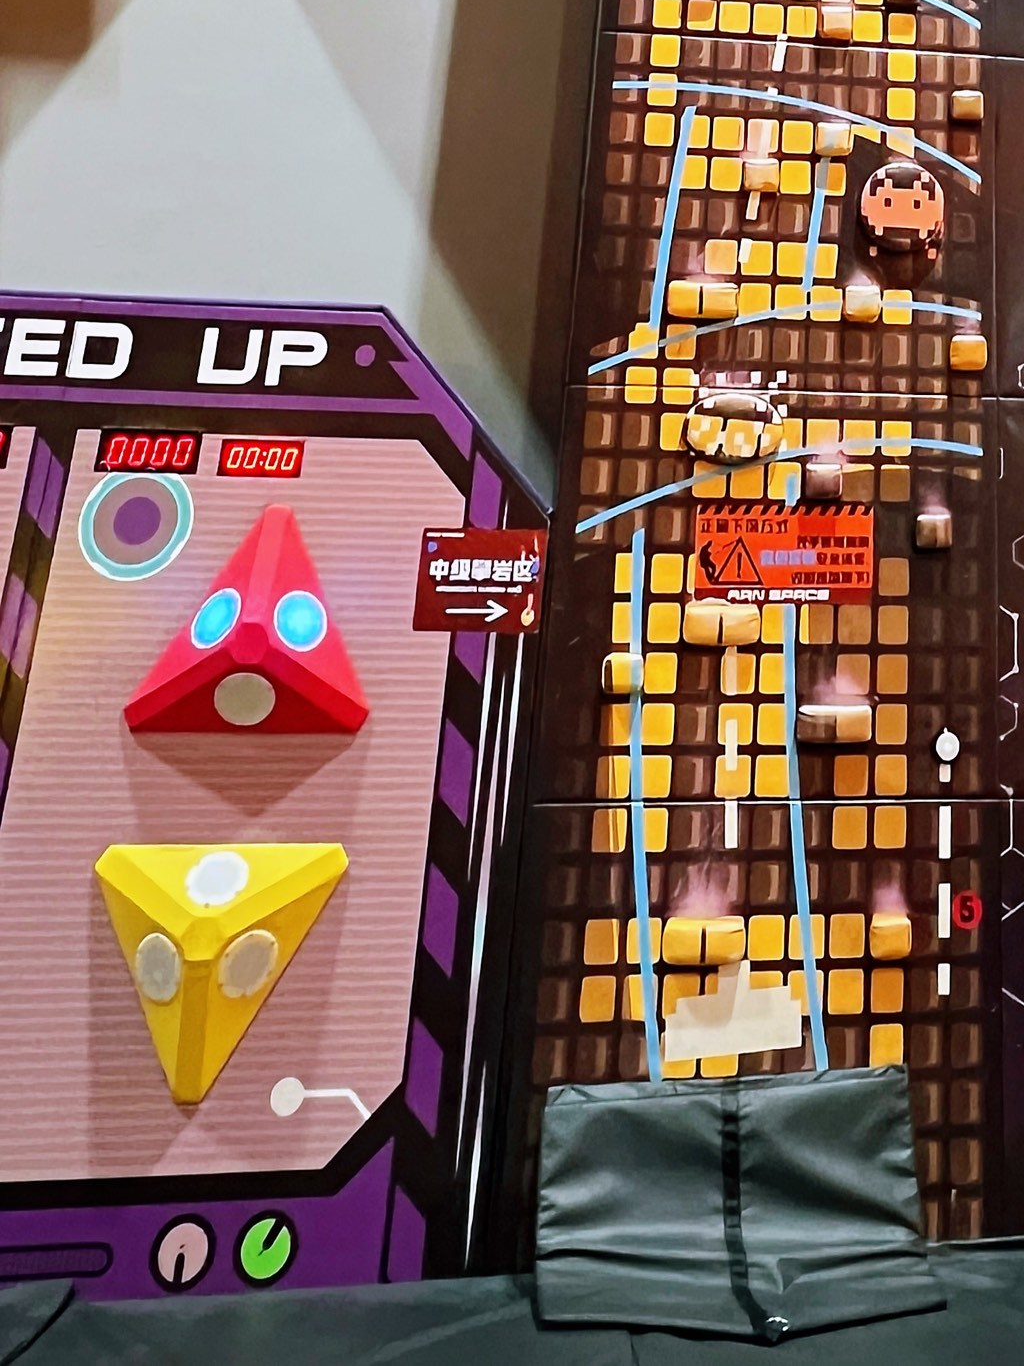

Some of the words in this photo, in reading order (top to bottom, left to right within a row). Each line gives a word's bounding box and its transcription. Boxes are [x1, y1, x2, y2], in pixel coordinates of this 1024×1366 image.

[0, 316, 134, 381] ED
[197, 326, 329, 387] UP
[226, 446, 299, 471] 00:00
